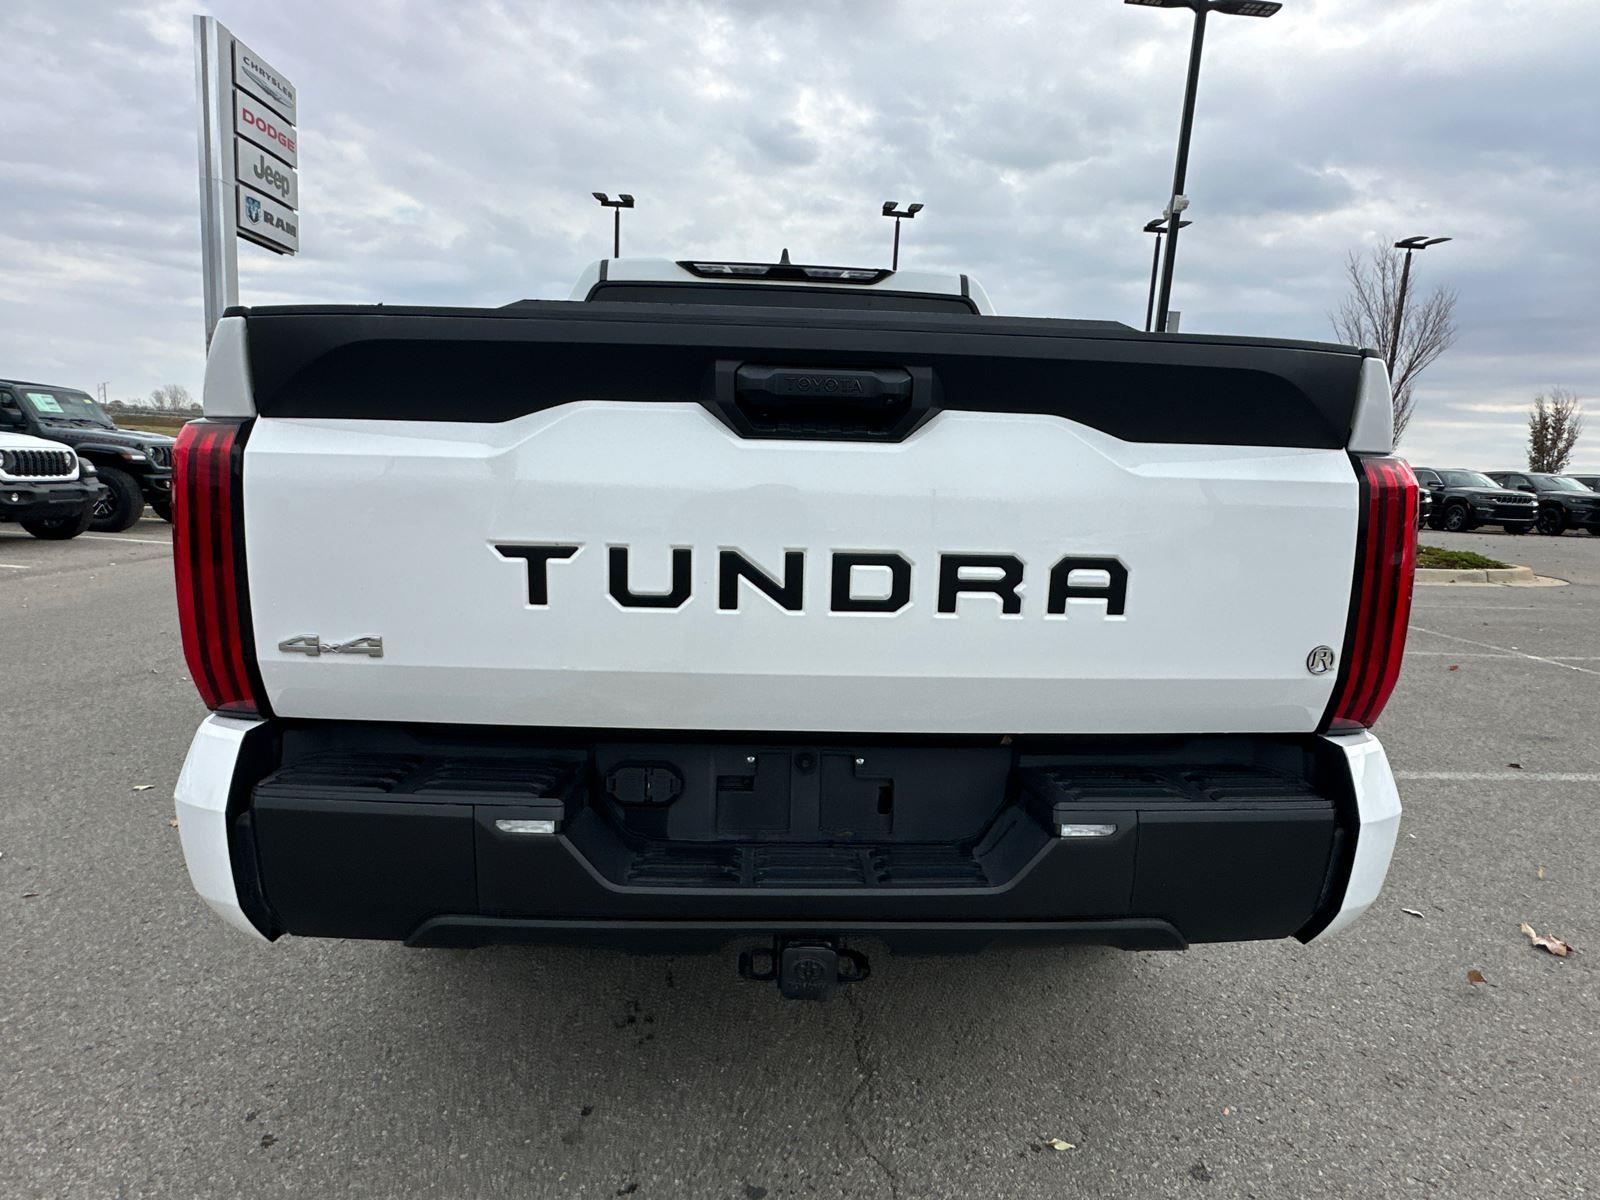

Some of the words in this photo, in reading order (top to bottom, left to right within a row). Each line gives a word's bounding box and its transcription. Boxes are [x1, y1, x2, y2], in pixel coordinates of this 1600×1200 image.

[243, 56, 293, 100] CHRYSLER
[243, 108, 295, 153] DODGE
[253, 155, 290, 198] Jeep
[263, 211, 297, 238] RAM
[785, 376, 864, 394] TOYOTA
[489, 542, 1129, 618] TUNDRA
